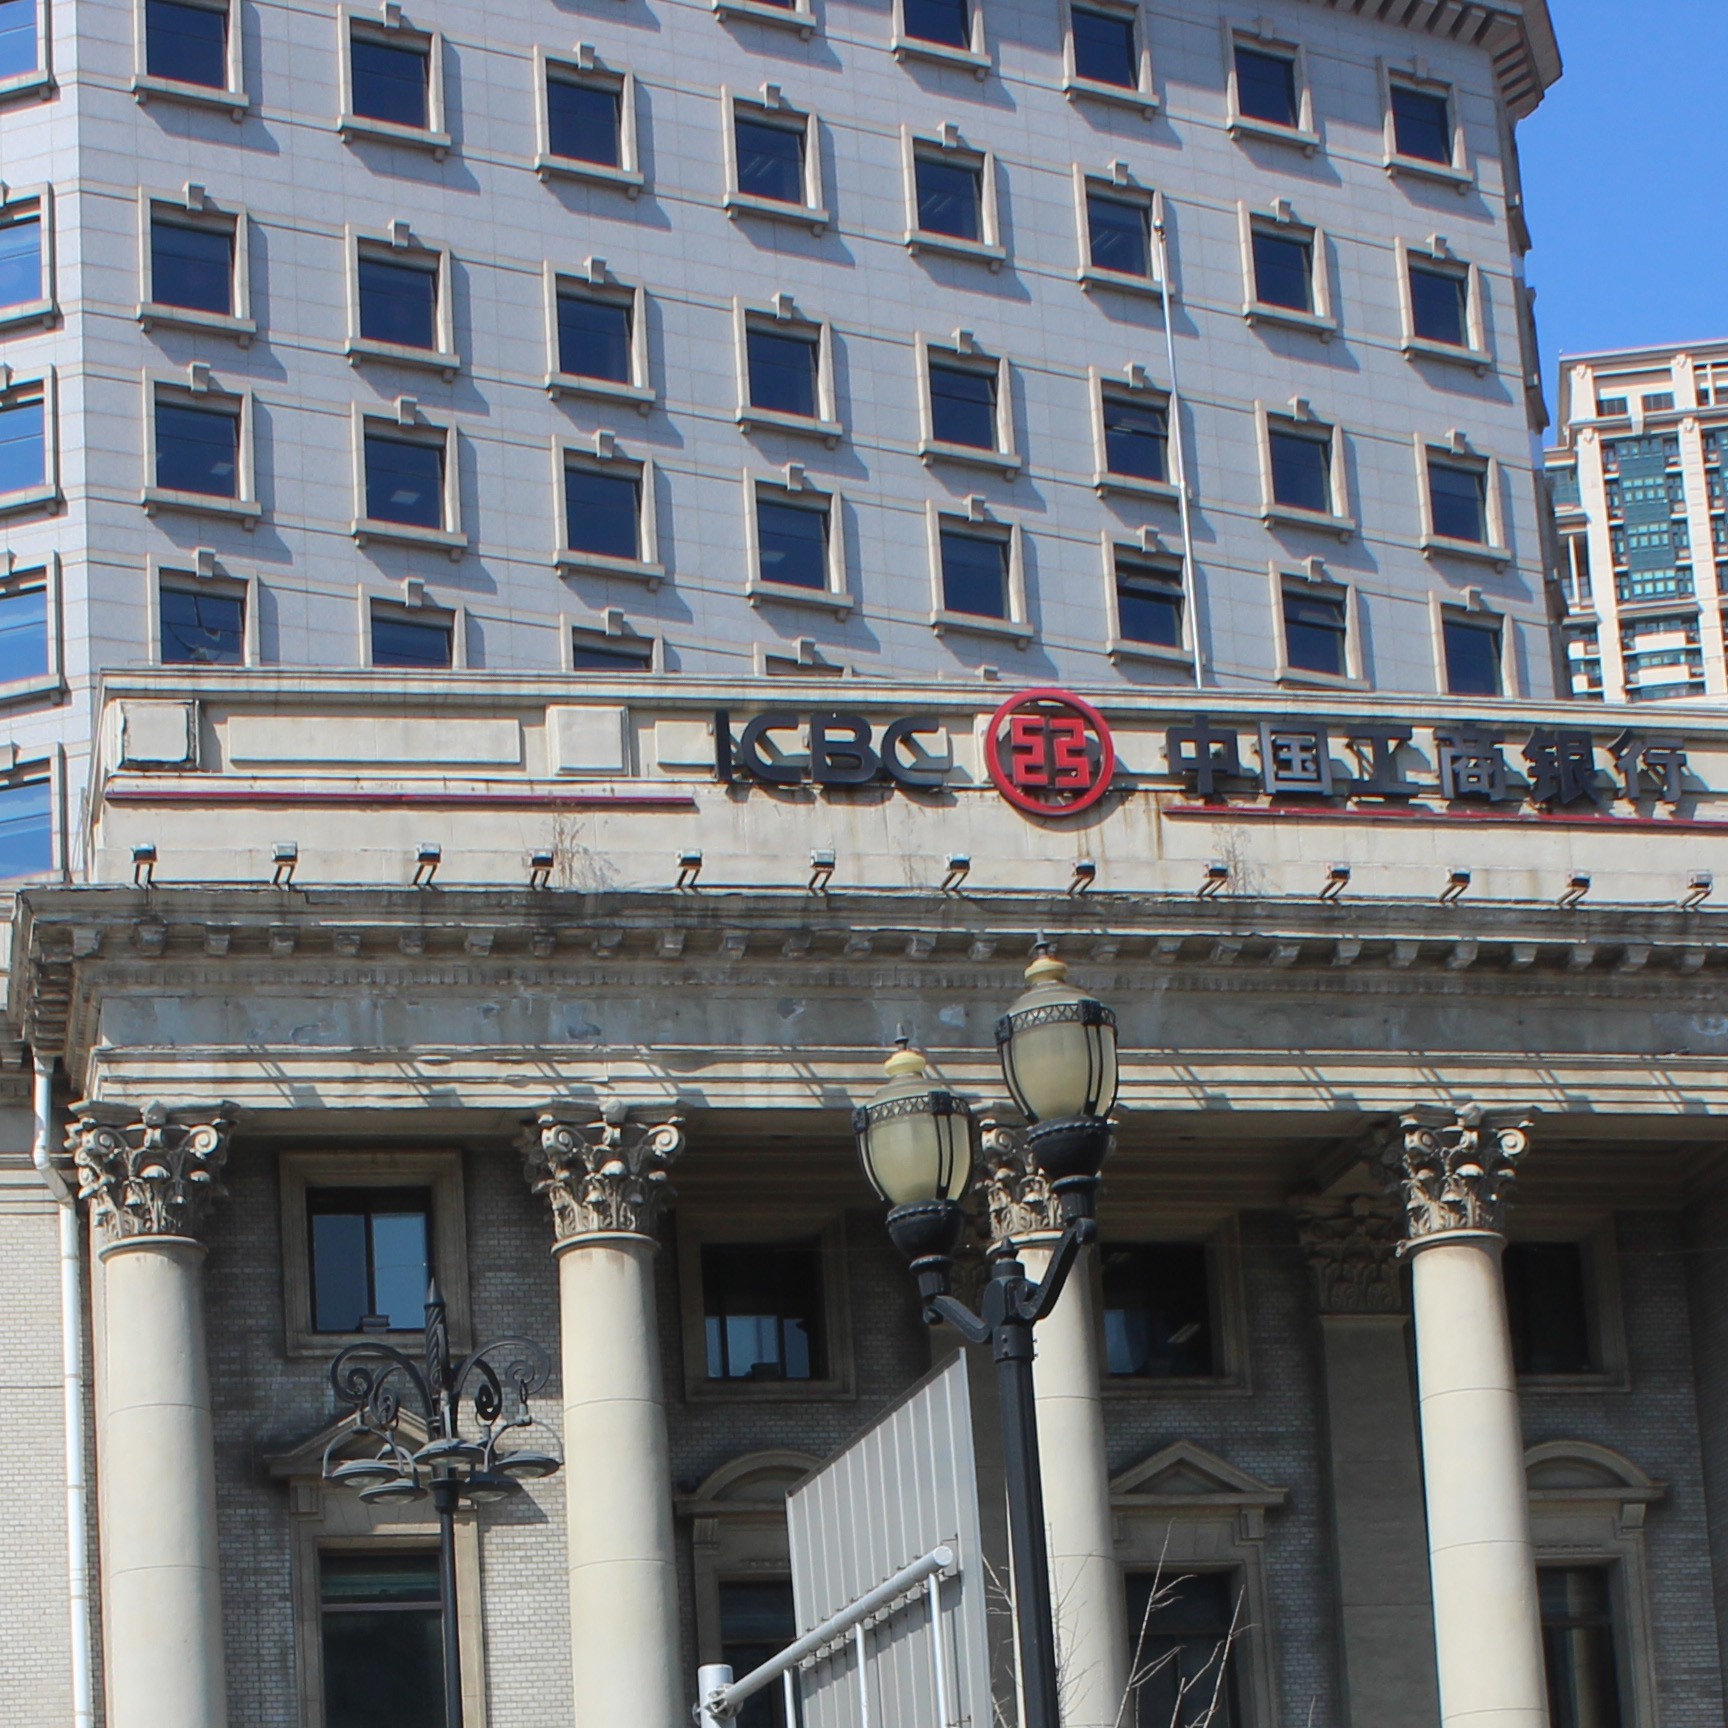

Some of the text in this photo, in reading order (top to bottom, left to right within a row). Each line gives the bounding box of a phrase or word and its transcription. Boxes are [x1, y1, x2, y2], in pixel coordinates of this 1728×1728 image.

[714, 709, 952, 787] ICBC
[1165, 714, 1688, 805] 中国工商银行
